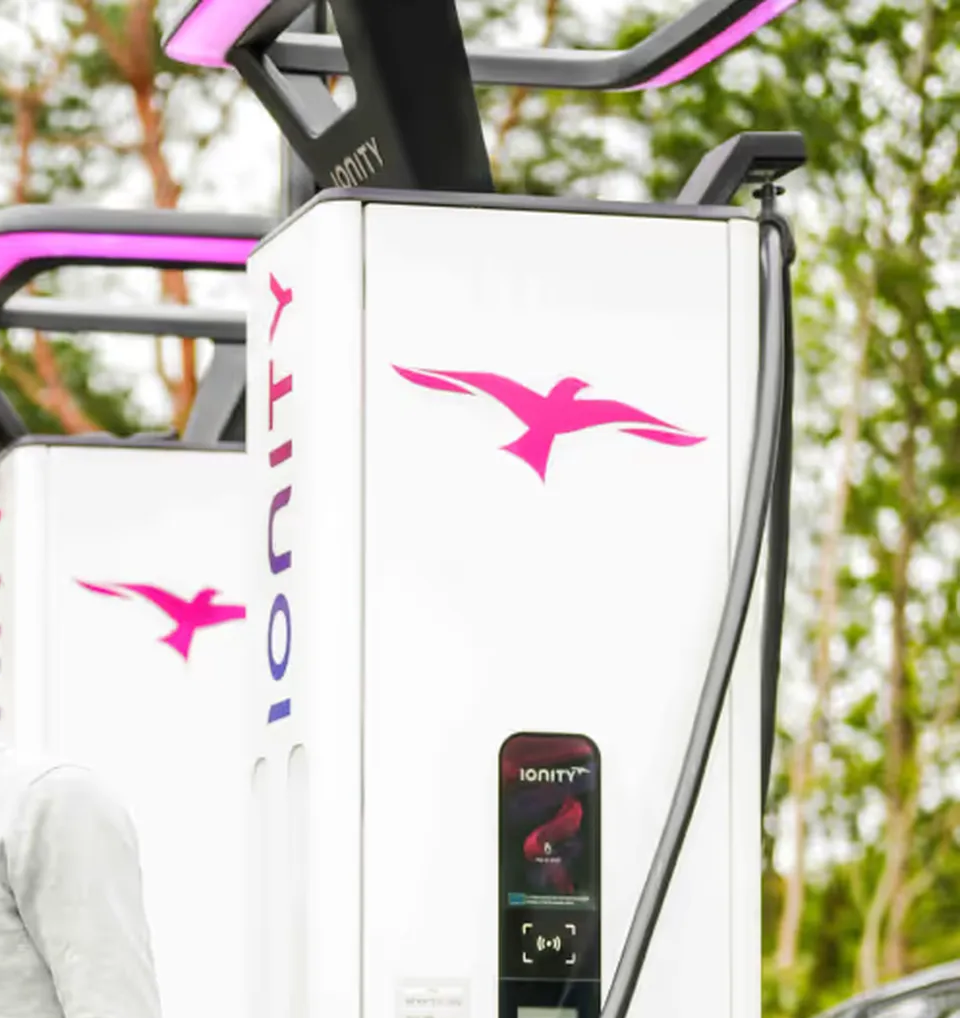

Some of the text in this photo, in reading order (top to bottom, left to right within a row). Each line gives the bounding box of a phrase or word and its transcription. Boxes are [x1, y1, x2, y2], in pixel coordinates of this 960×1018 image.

[329, 136, 384, 188] IONITY
[267, 272, 293, 724] IONITY
[519, 767, 577, 783] IONITY
